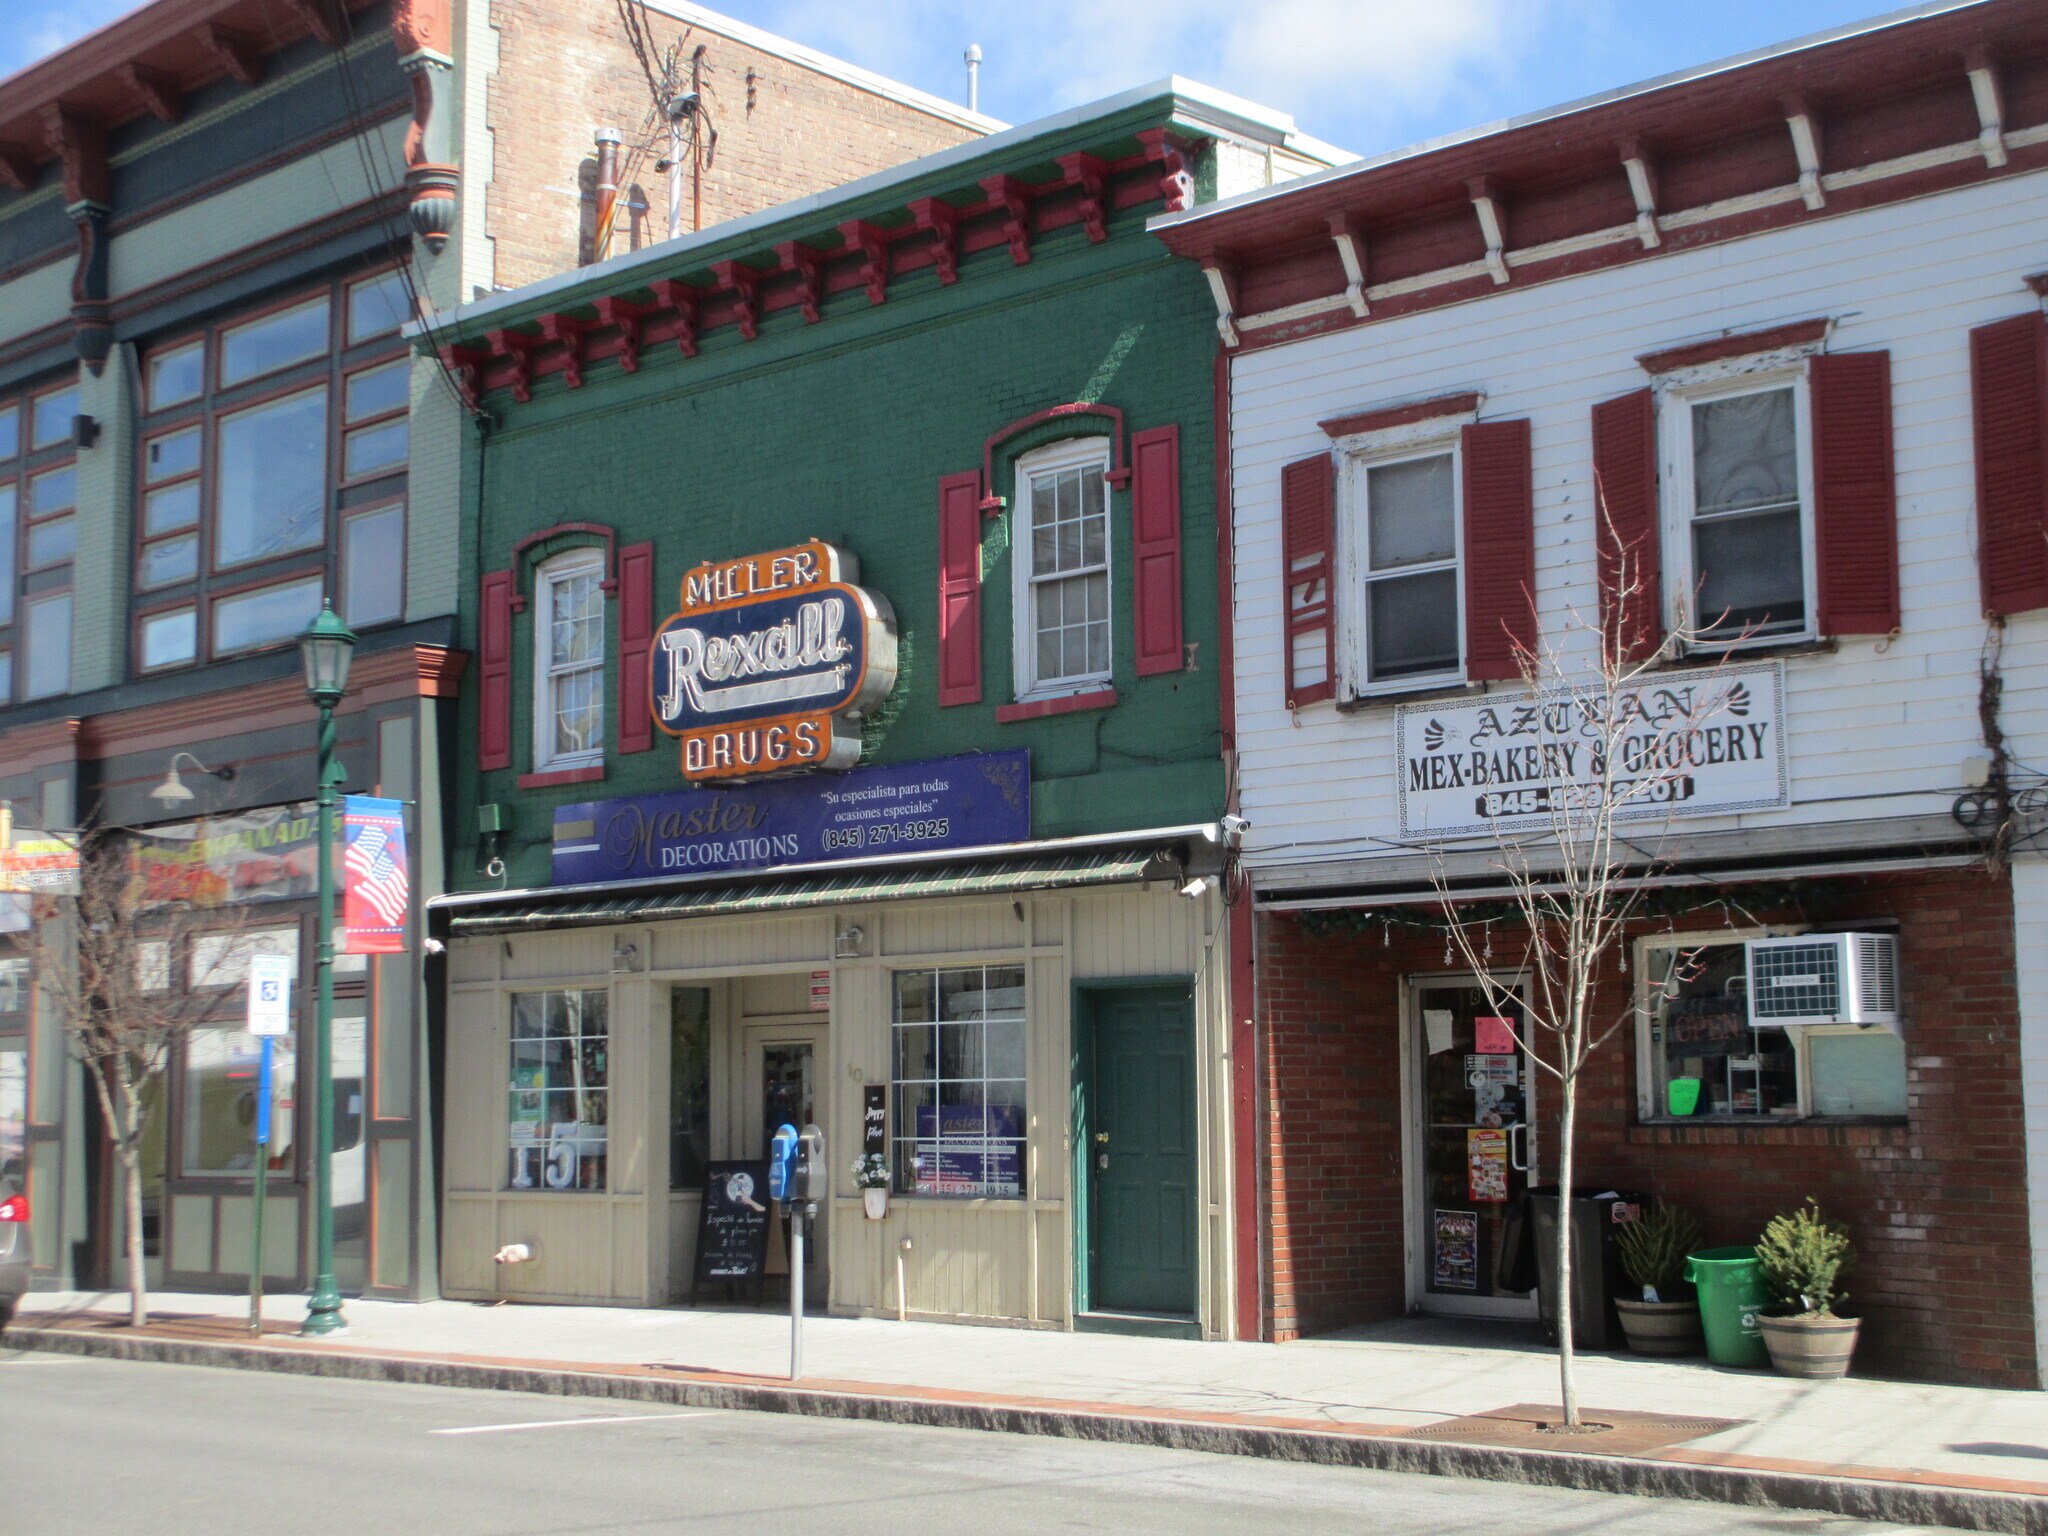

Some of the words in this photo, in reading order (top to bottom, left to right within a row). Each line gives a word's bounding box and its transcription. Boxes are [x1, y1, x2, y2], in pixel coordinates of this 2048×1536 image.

[686, 551, 821, 606] MILLER
[657, 598, 852, 721] Rexall
[686, 721, 820, 772] DRUGS
[1622, 722, 1769, 774] GROCERY
[842, 784, 896, 805] especialista
[899, 783, 920, 799] para
[923, 778, 949, 792] todas
[604, 796, 770, 871] Master
[822, 826, 865, 851] (845)
[869, 818, 949, 845] 271-3925
[835, 807, 881, 823] ocasiones
[661, 833, 799, 868] DECORATIONS
[1675, 1013, 1740, 1042] OPEN
